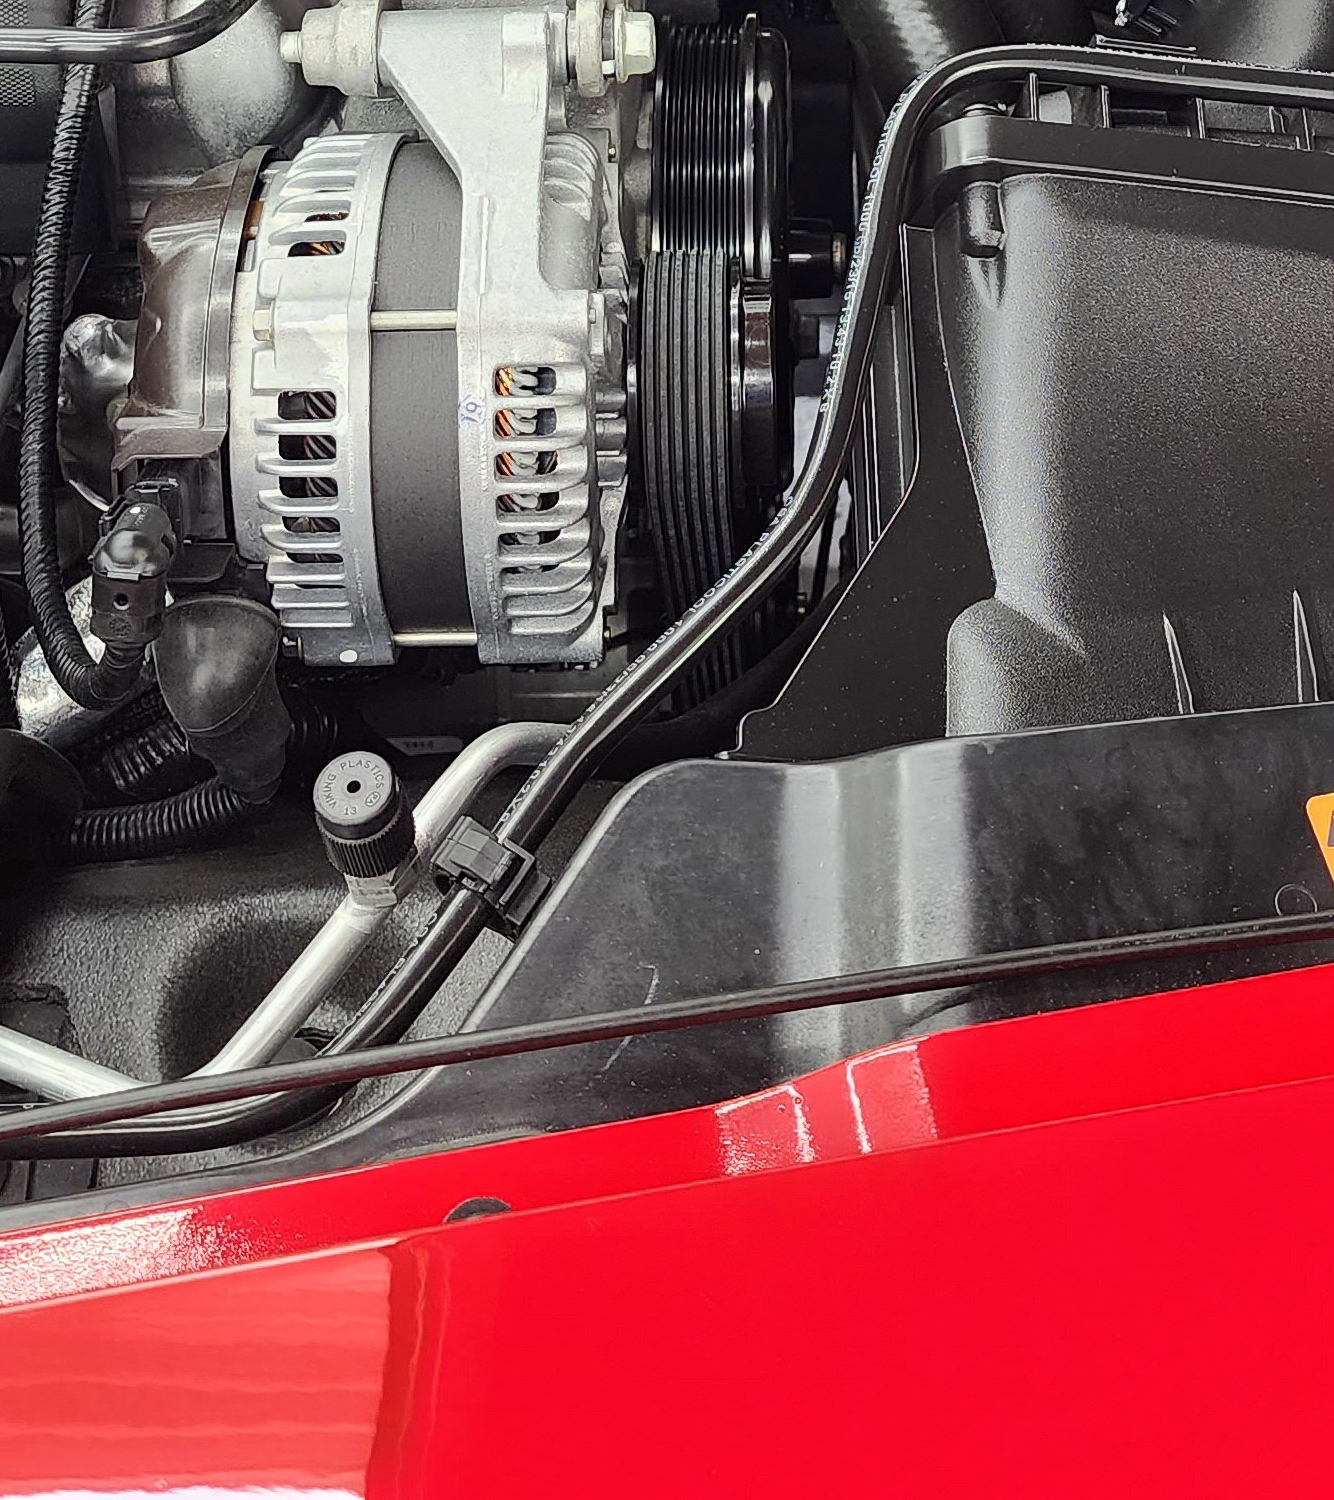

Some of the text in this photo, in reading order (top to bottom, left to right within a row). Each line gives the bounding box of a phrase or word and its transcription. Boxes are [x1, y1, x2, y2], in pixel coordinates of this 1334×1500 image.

[322, 759, 385, 809] VIKING PLASTICS
[343, 806, 357, 816] 13
